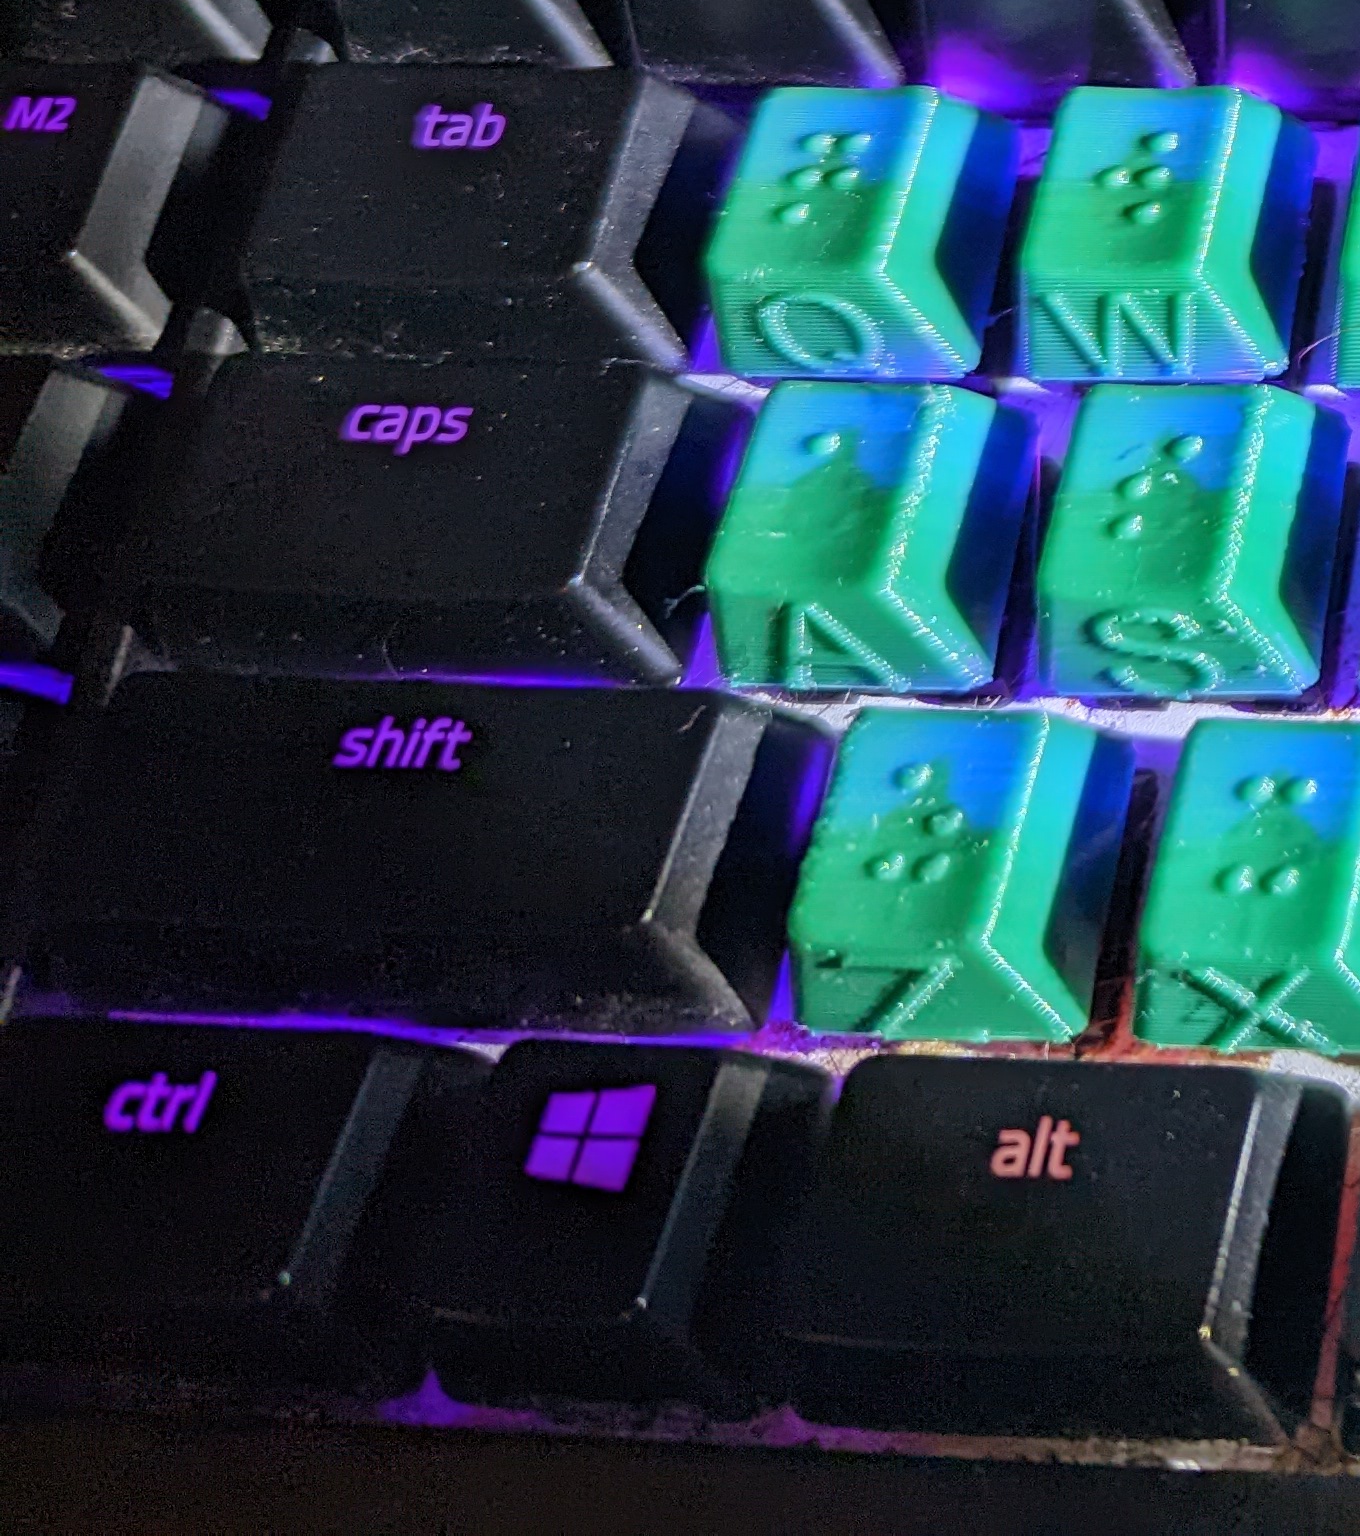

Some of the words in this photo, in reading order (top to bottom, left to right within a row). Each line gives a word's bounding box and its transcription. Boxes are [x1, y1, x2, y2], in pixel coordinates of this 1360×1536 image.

[4, 95, 75, 133] M2
[413, 104, 506, 149] tab
[1040, 289, 1200, 377] W
[341, 403, 473, 454] caps
[772, 600, 911, 692] A
[1083, 607, 1228, 700] S
[333, 716, 473, 770] shift
[1173, 965, 1342, 1055] X
[103, 1072, 217, 1136] ctrl
[988, 1116, 1080, 1182] alt
